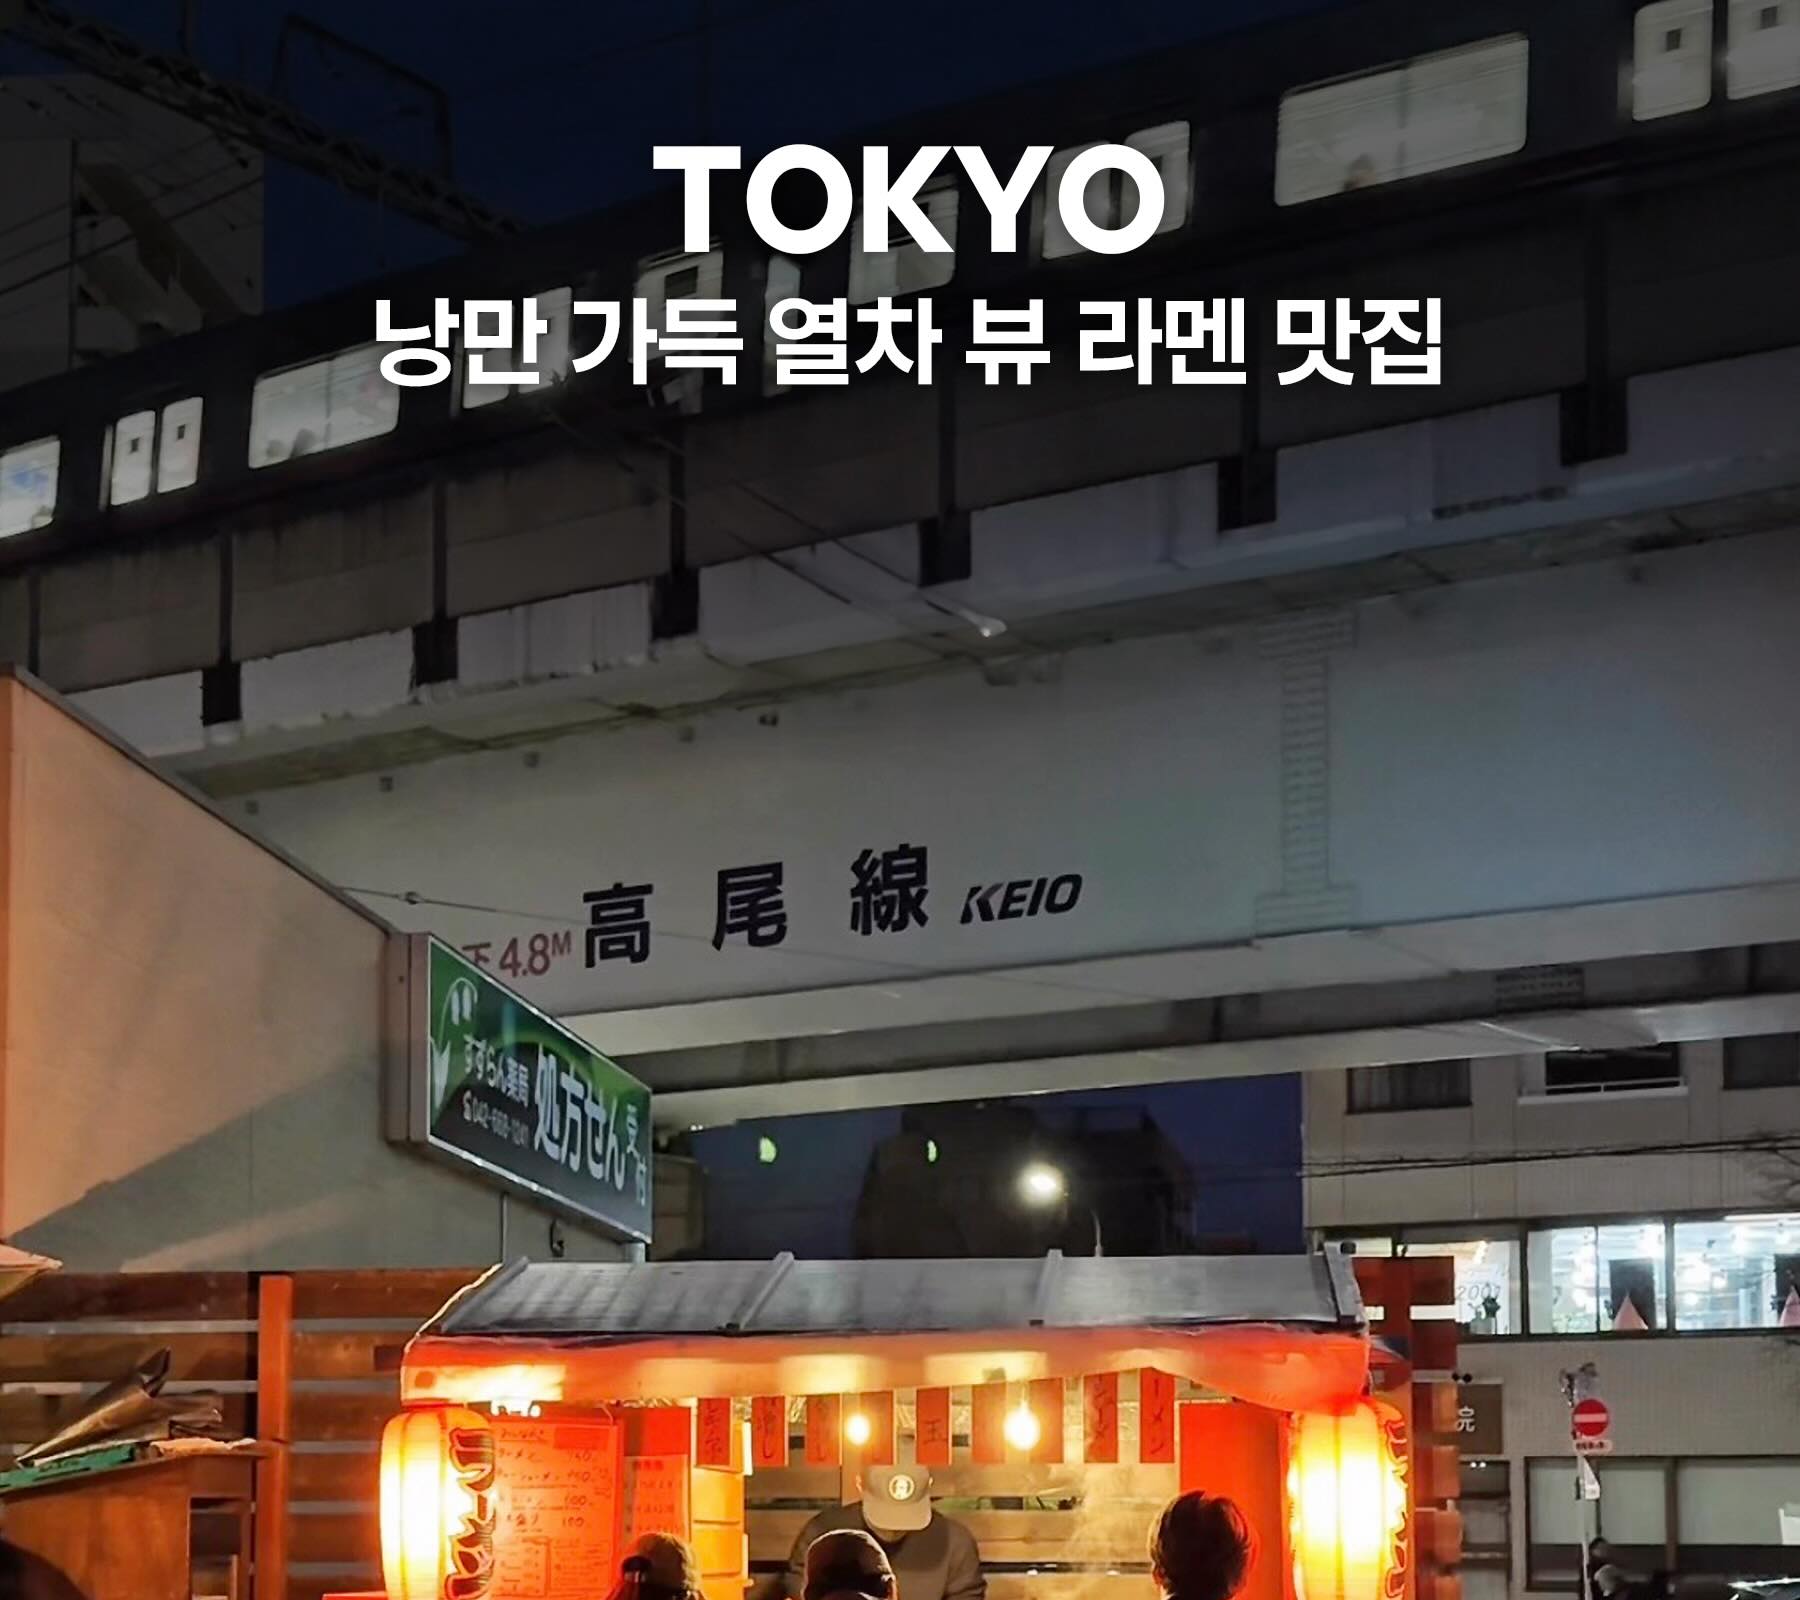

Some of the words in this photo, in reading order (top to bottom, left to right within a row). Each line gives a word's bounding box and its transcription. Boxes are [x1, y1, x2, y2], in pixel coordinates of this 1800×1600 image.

[583, 843, 930, 970] 高尾線
[959, 873, 1083, 925] KEIO
[534, 1042, 627, 1191] 処方せん
